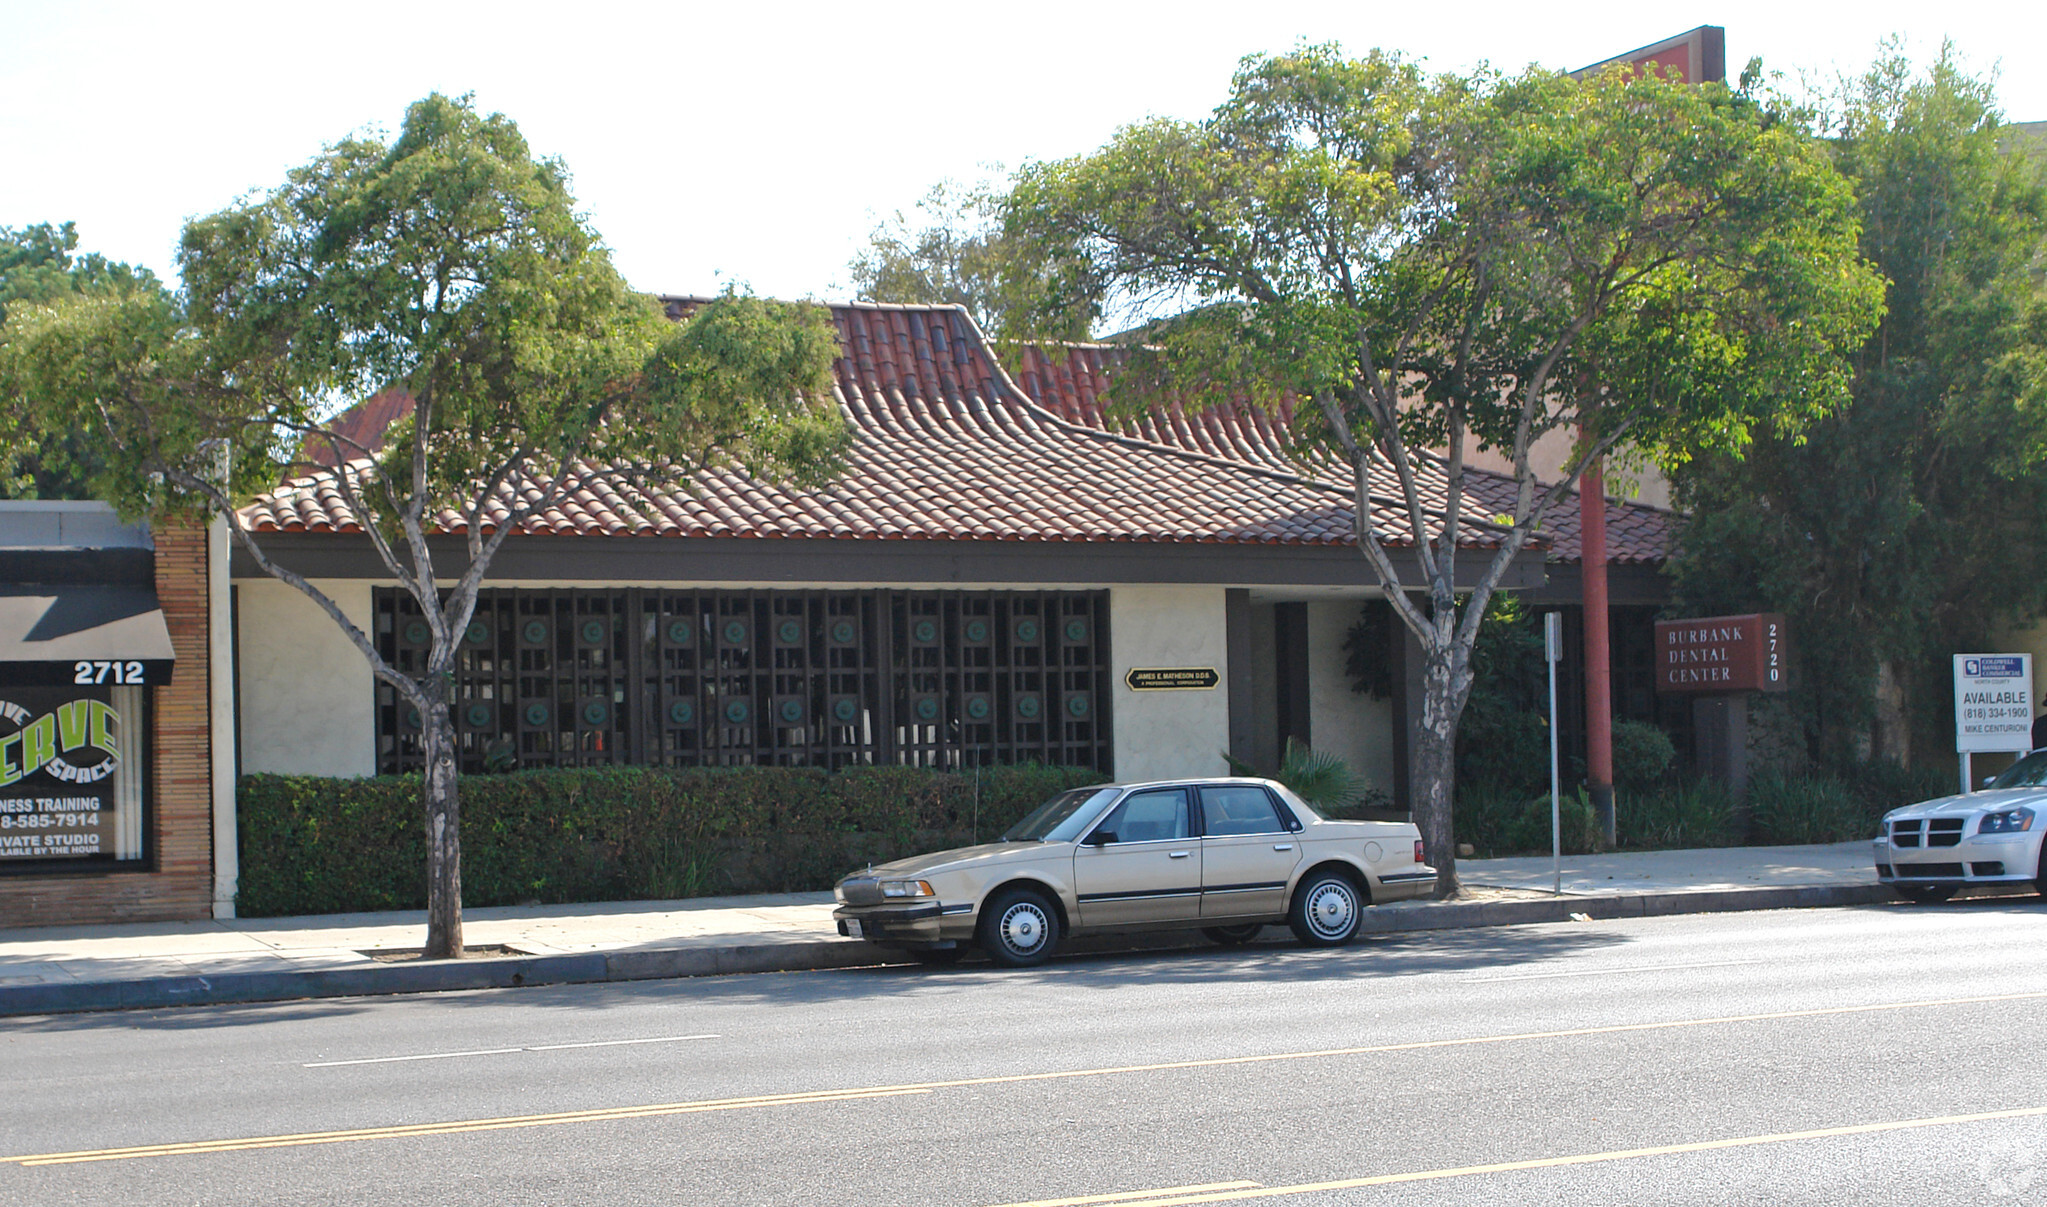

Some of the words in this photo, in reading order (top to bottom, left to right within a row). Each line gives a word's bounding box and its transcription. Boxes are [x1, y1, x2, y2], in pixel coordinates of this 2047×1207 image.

[1669, 627, 1742, 645] BURBANK
[1669, 648, 1728, 663] DENTAL
[1769, 624, 1779, 681] 2720
[74, 661, 144, 684] 2712
[1669, 667, 1730, 683] CENTER
[1964, 691, 2026, 704] AVAILABLE
[1964, 707, 1986, 720] (818)
[1988, 707, 2028, 718] 334-1900
[1964, 724, 1983, 732] MIKE
[1984, 724, 2028, 732] CENTURIONI
[45, 757, 116, 783] SPACE
[36, 797, 100, 812] TRAINING
[0, 813, 99, 829] 8-585-7914
[44, 833, 100, 846] STUDIO
[50, 846, 69, 854] THE
[71, 845, 100, 853] HOUR
